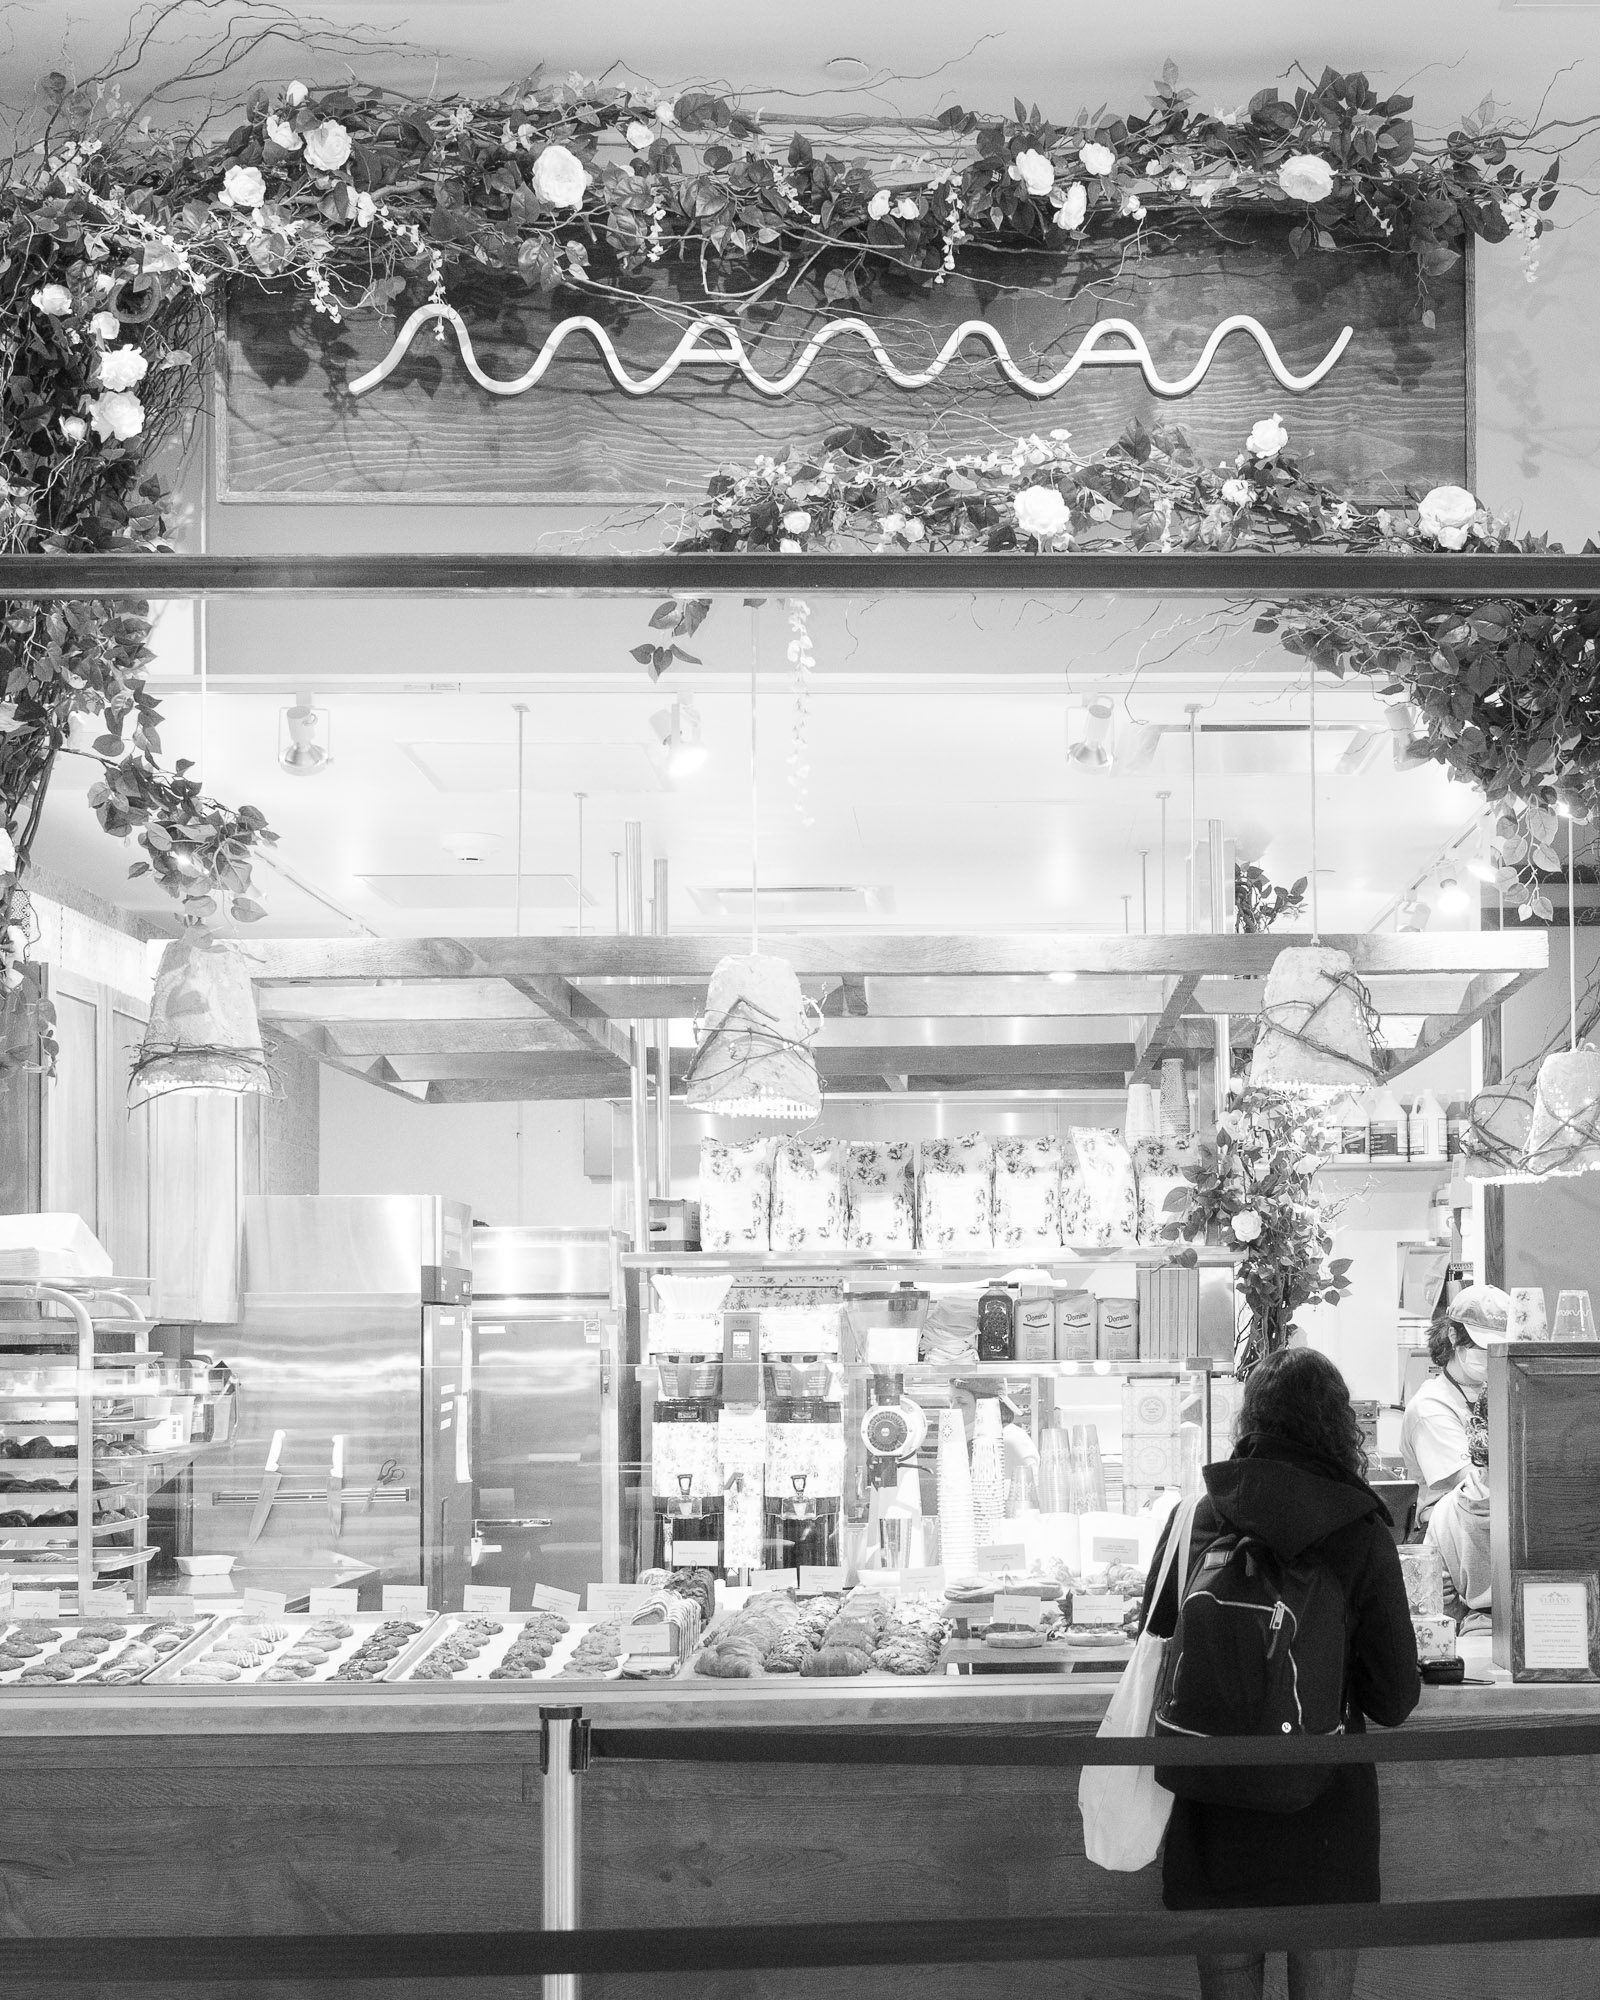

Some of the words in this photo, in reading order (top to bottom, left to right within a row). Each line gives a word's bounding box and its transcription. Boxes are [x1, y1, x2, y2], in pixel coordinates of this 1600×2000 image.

[1025, 1312, 1048, 1322] Domino
[1066, 1312, 1088, 1322] Domino
[1107, 1314, 1129, 1323] Domino
